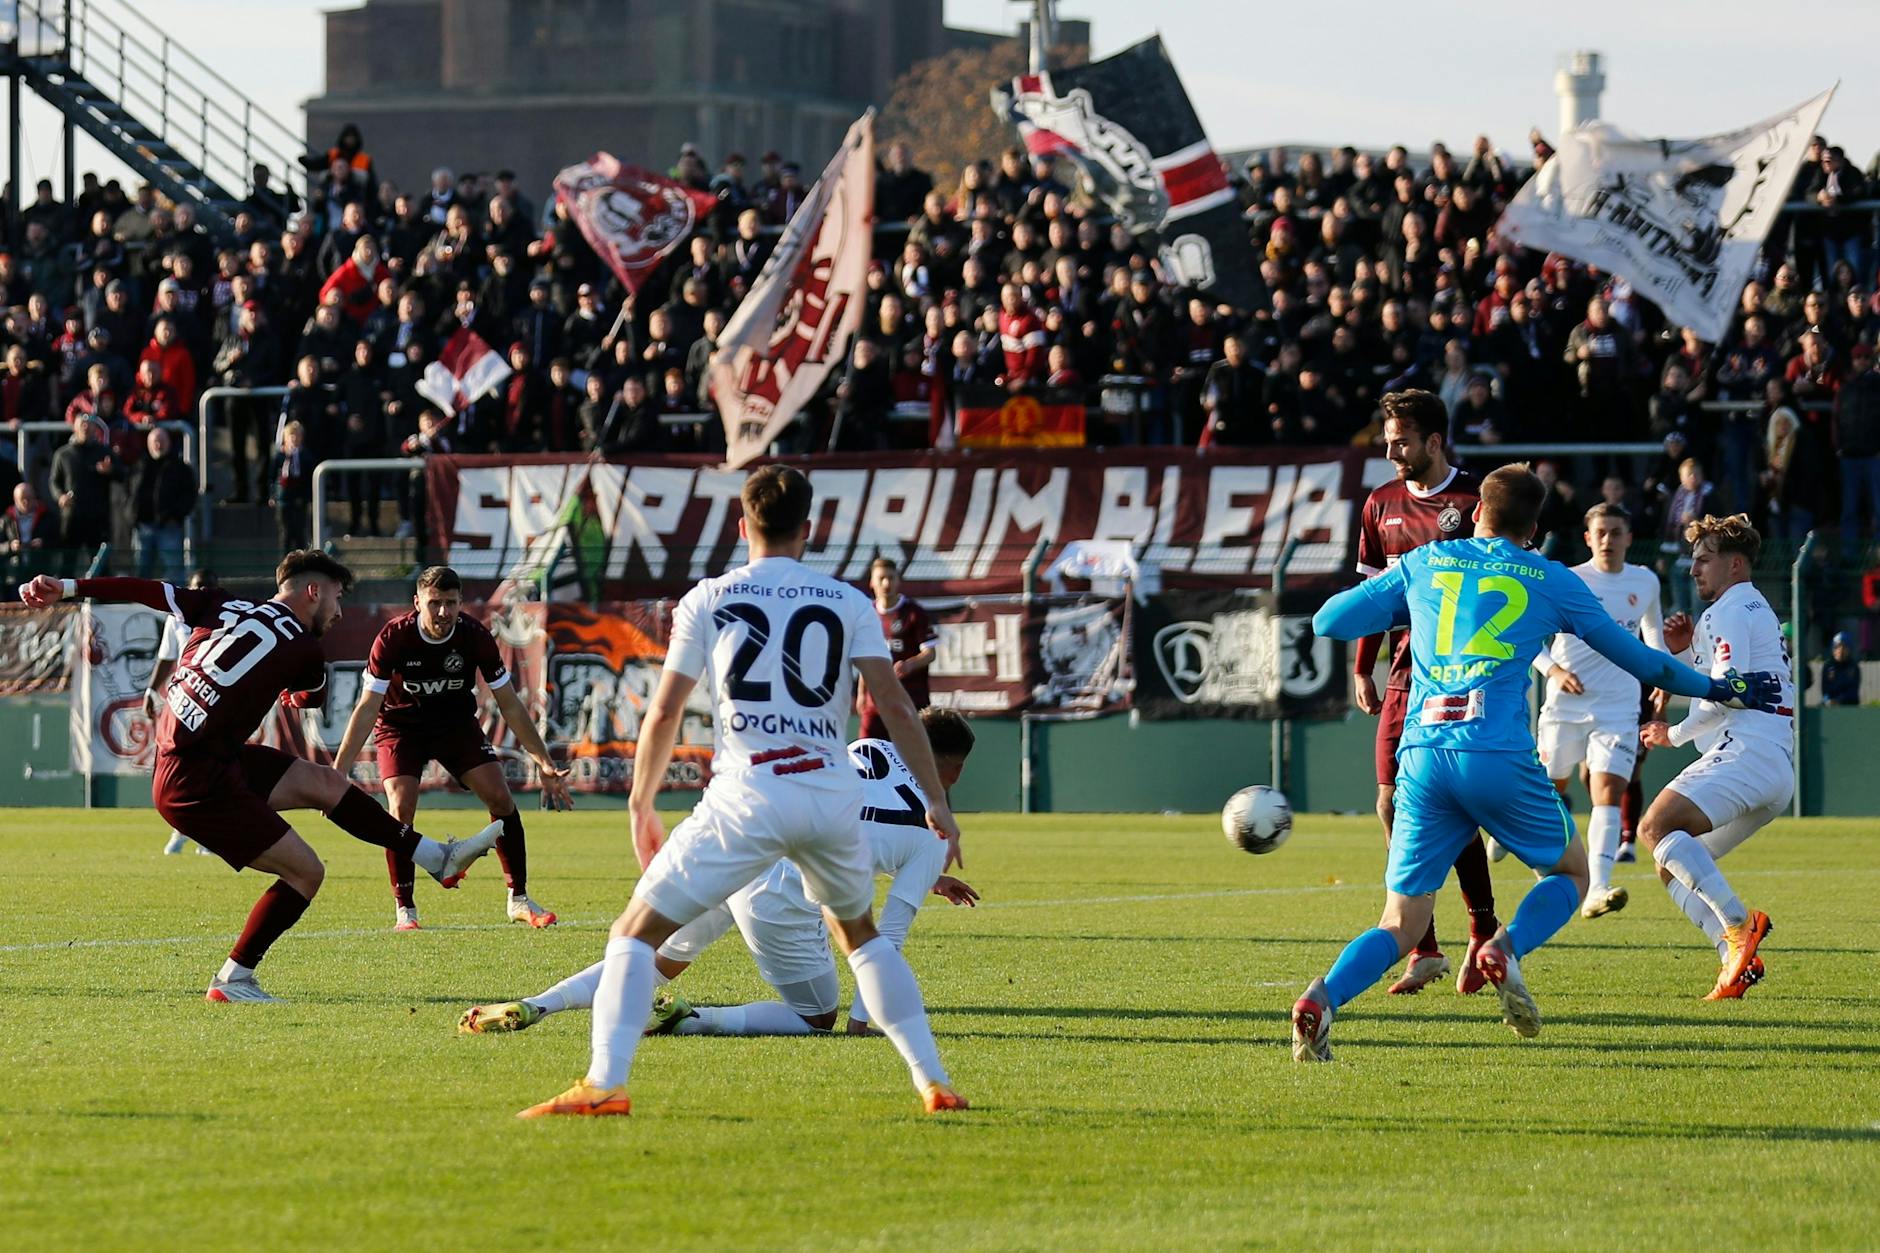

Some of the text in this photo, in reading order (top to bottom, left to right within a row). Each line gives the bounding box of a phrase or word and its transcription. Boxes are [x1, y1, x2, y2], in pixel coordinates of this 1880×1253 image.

[447, 462, 1070, 581] SPORTORUM
[1384, 517, 1403, 526] JAKO
[777, 585, 843, 600] COTTBUS
[1427, 556, 1546, 581] ENERGIE COTTBUS
[221, 599, 304, 641] BFC
[1431, 571, 1529, 661] 12
[190, 610, 278, 687] 10
[712, 602, 844, 708] 20
